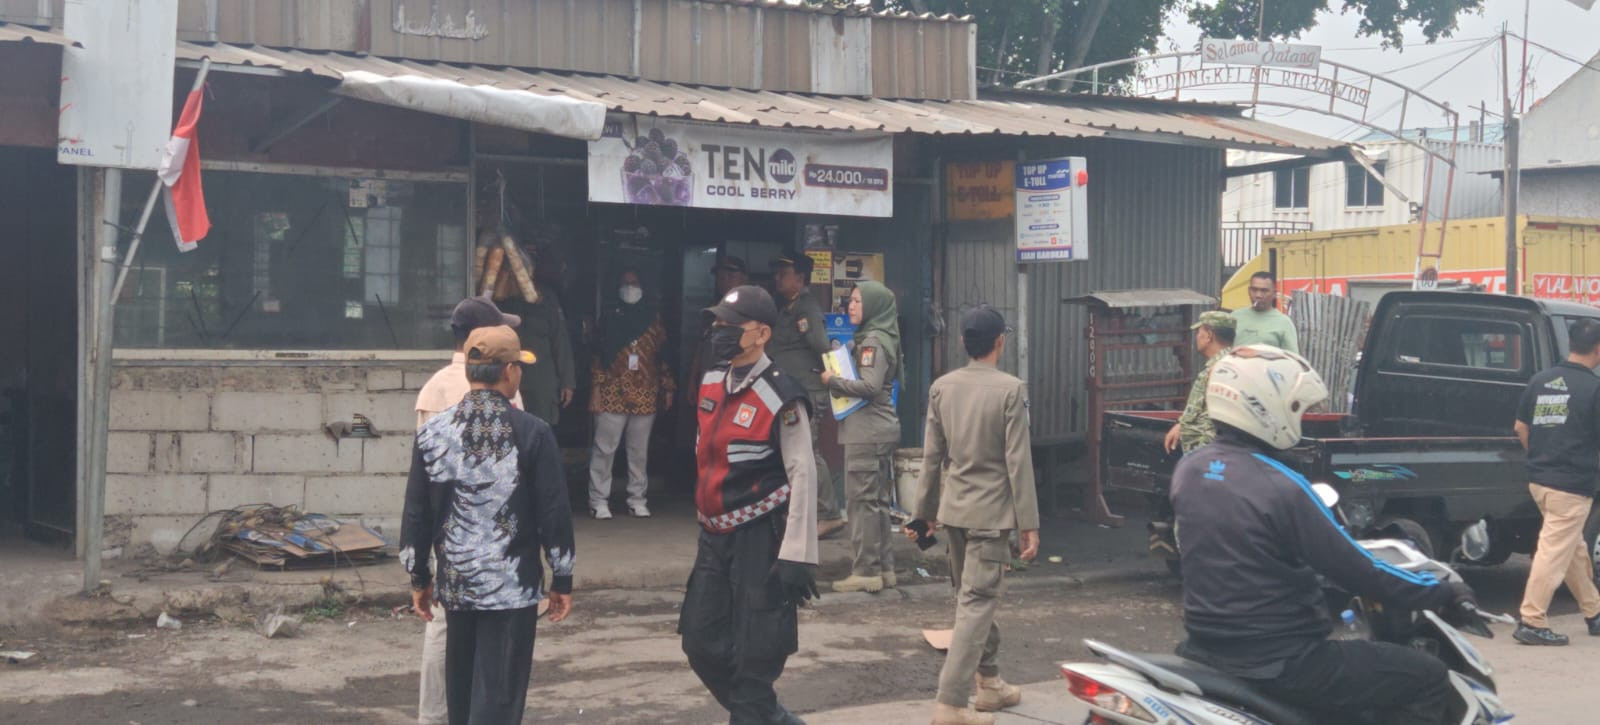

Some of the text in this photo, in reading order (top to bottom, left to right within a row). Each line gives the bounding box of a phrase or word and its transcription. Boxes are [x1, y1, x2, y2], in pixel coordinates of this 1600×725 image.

[1206, 41, 1259, 61] Selamat
[701, 143, 797, 182] TEN mild
[1023, 165, 1036, 176] TOP
[1037, 164, 1048, 175] UP
[1024, 176, 1048, 187] E-TOLL
[707, 185, 796, 200] COOL BERRY
